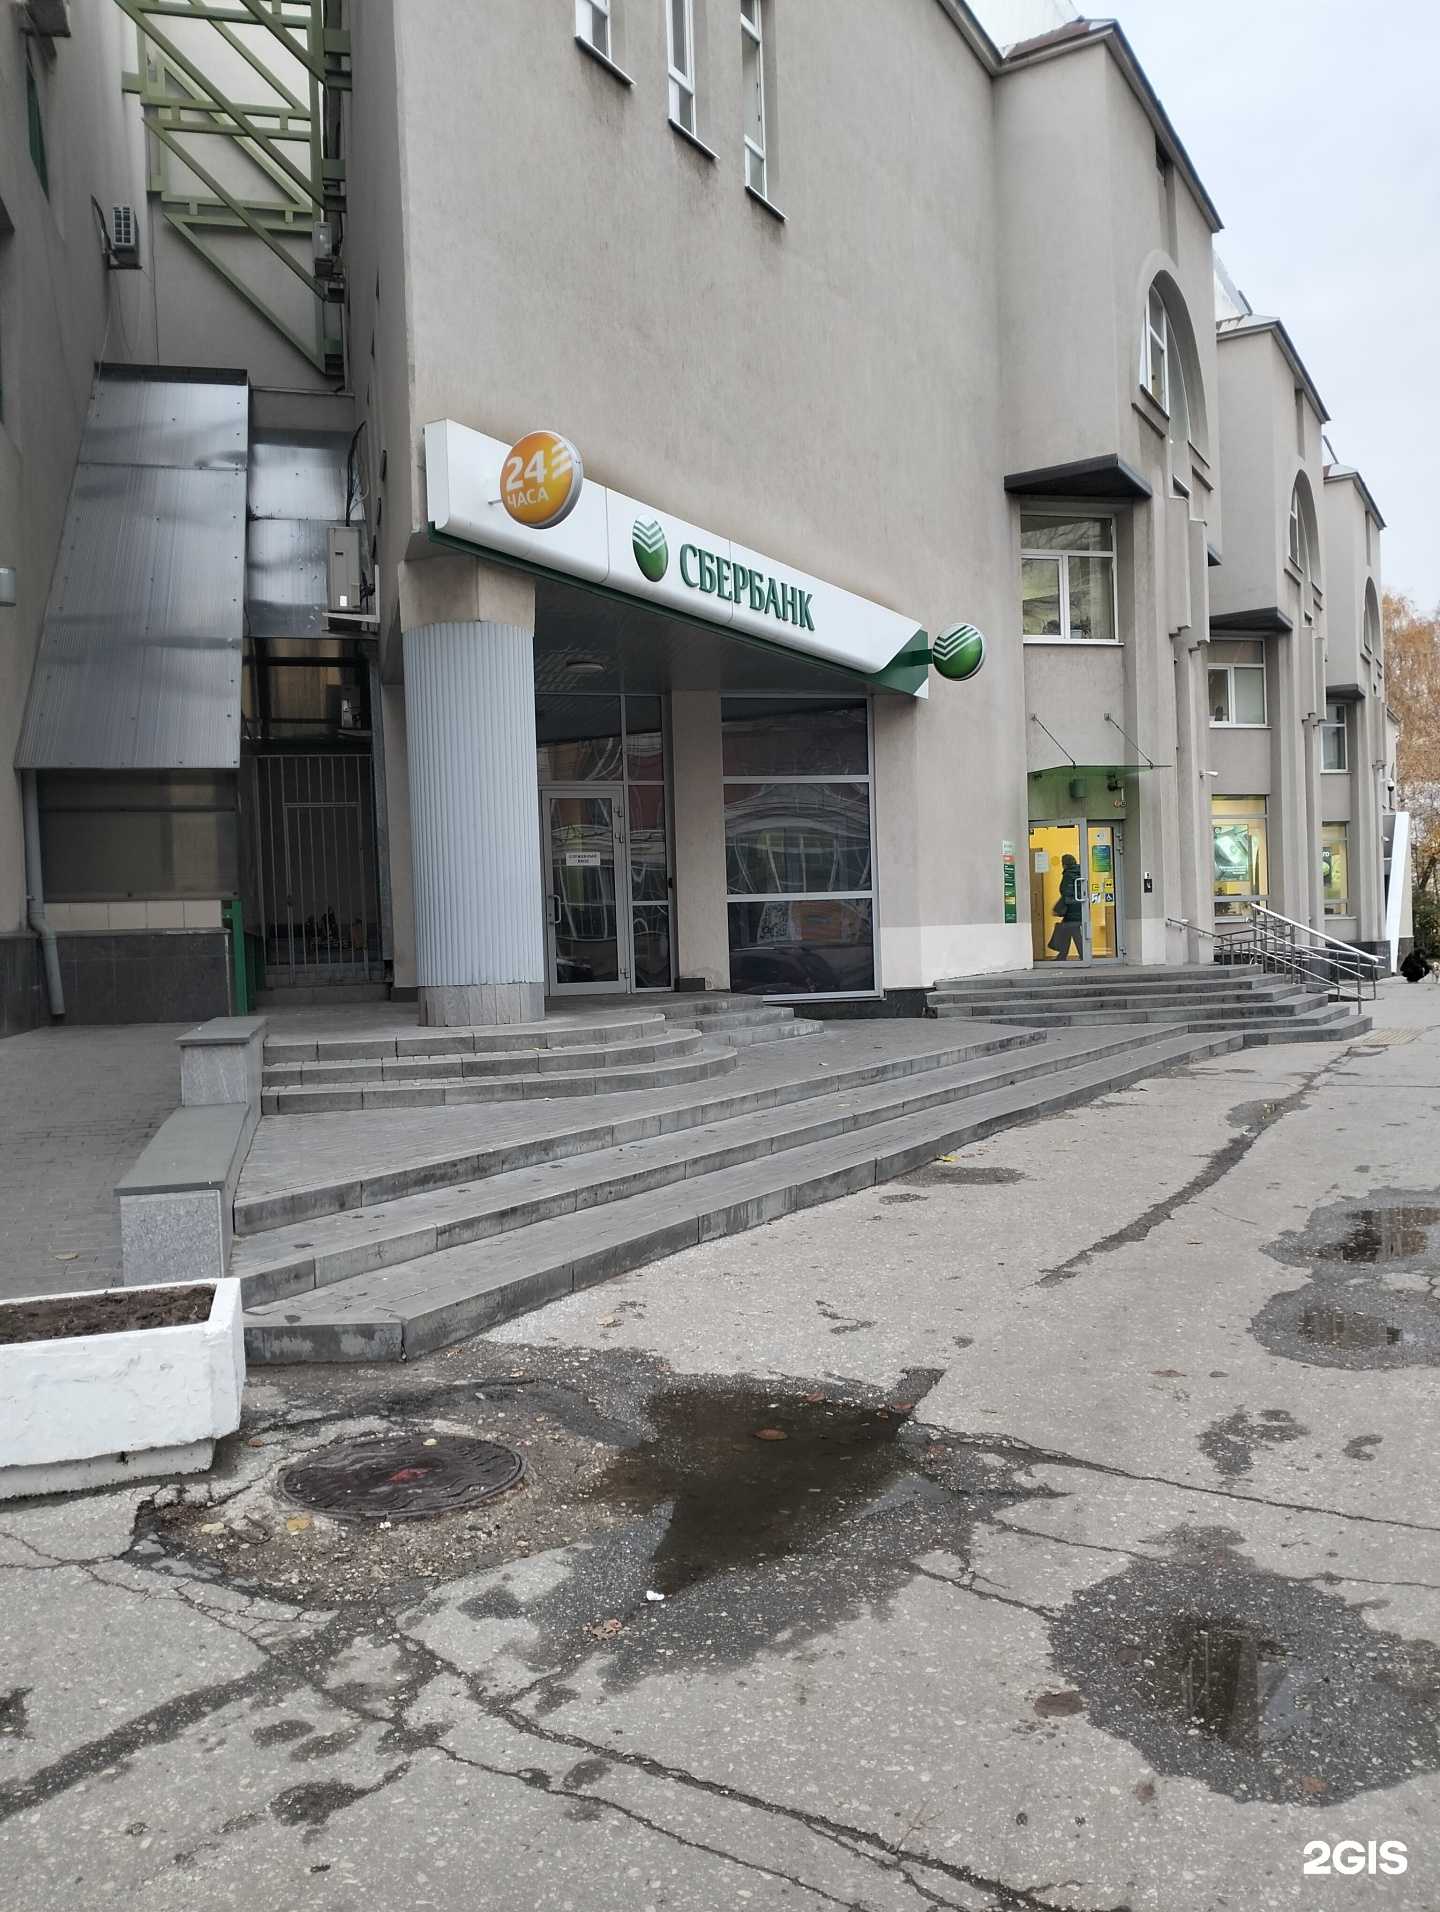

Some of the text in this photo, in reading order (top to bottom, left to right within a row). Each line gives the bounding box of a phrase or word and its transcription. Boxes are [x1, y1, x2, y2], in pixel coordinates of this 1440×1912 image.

[506, 450, 547, 492] 24
[507, 487, 549, 508] ЧАСА
[679, 543, 816, 631] СБЕРБАНК
